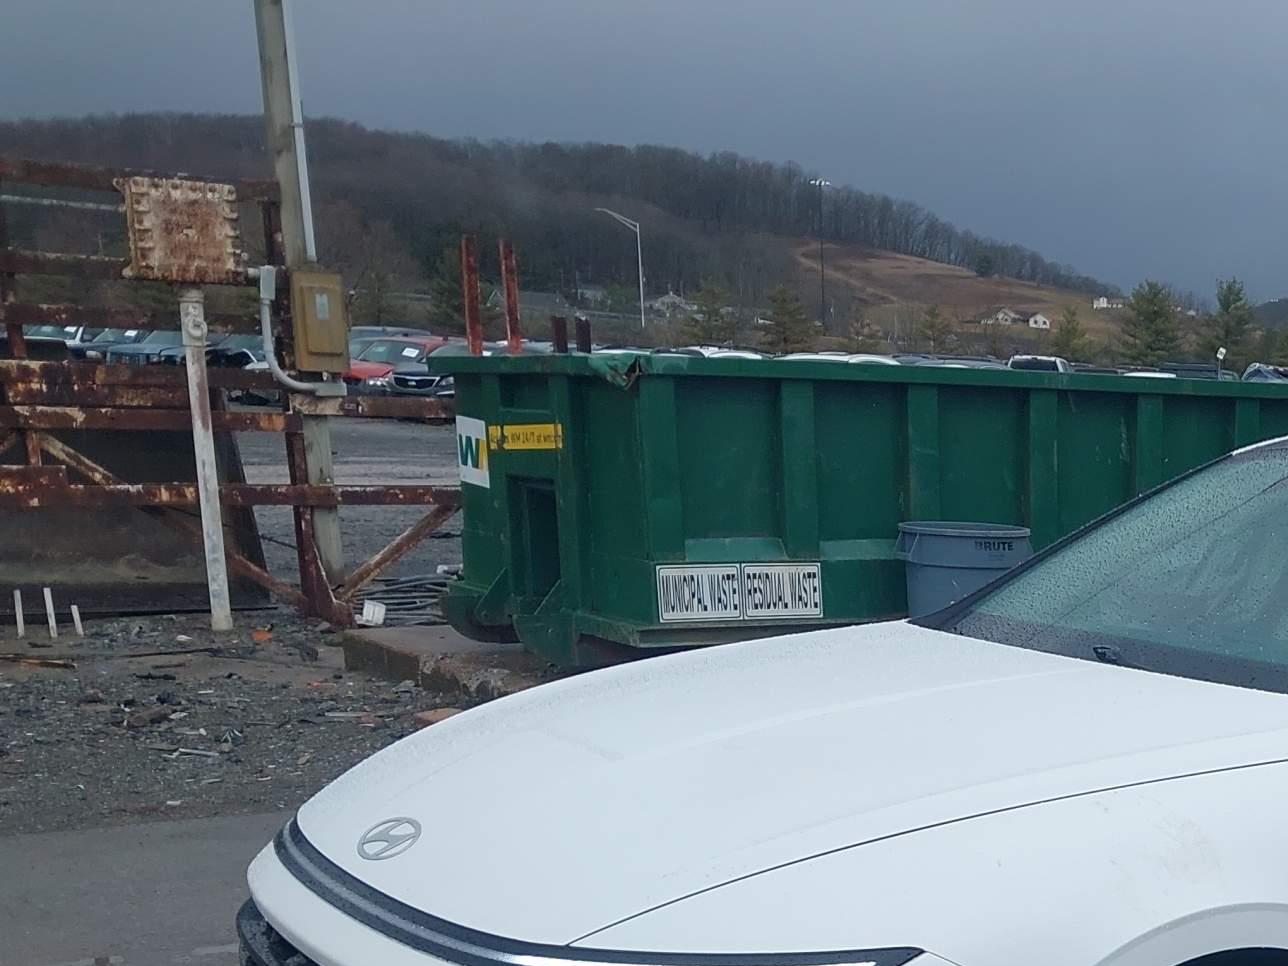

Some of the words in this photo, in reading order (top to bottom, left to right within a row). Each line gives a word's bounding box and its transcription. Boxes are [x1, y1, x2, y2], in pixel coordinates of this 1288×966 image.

[974, 541, 1014, 552] BRUTE
[661, 574, 708, 613] MUNICIPAL
[708, 574, 738, 611] WASTE
[746, 572, 788, 610] RESIDUAL
[789, 572, 818, 609] WASTE
